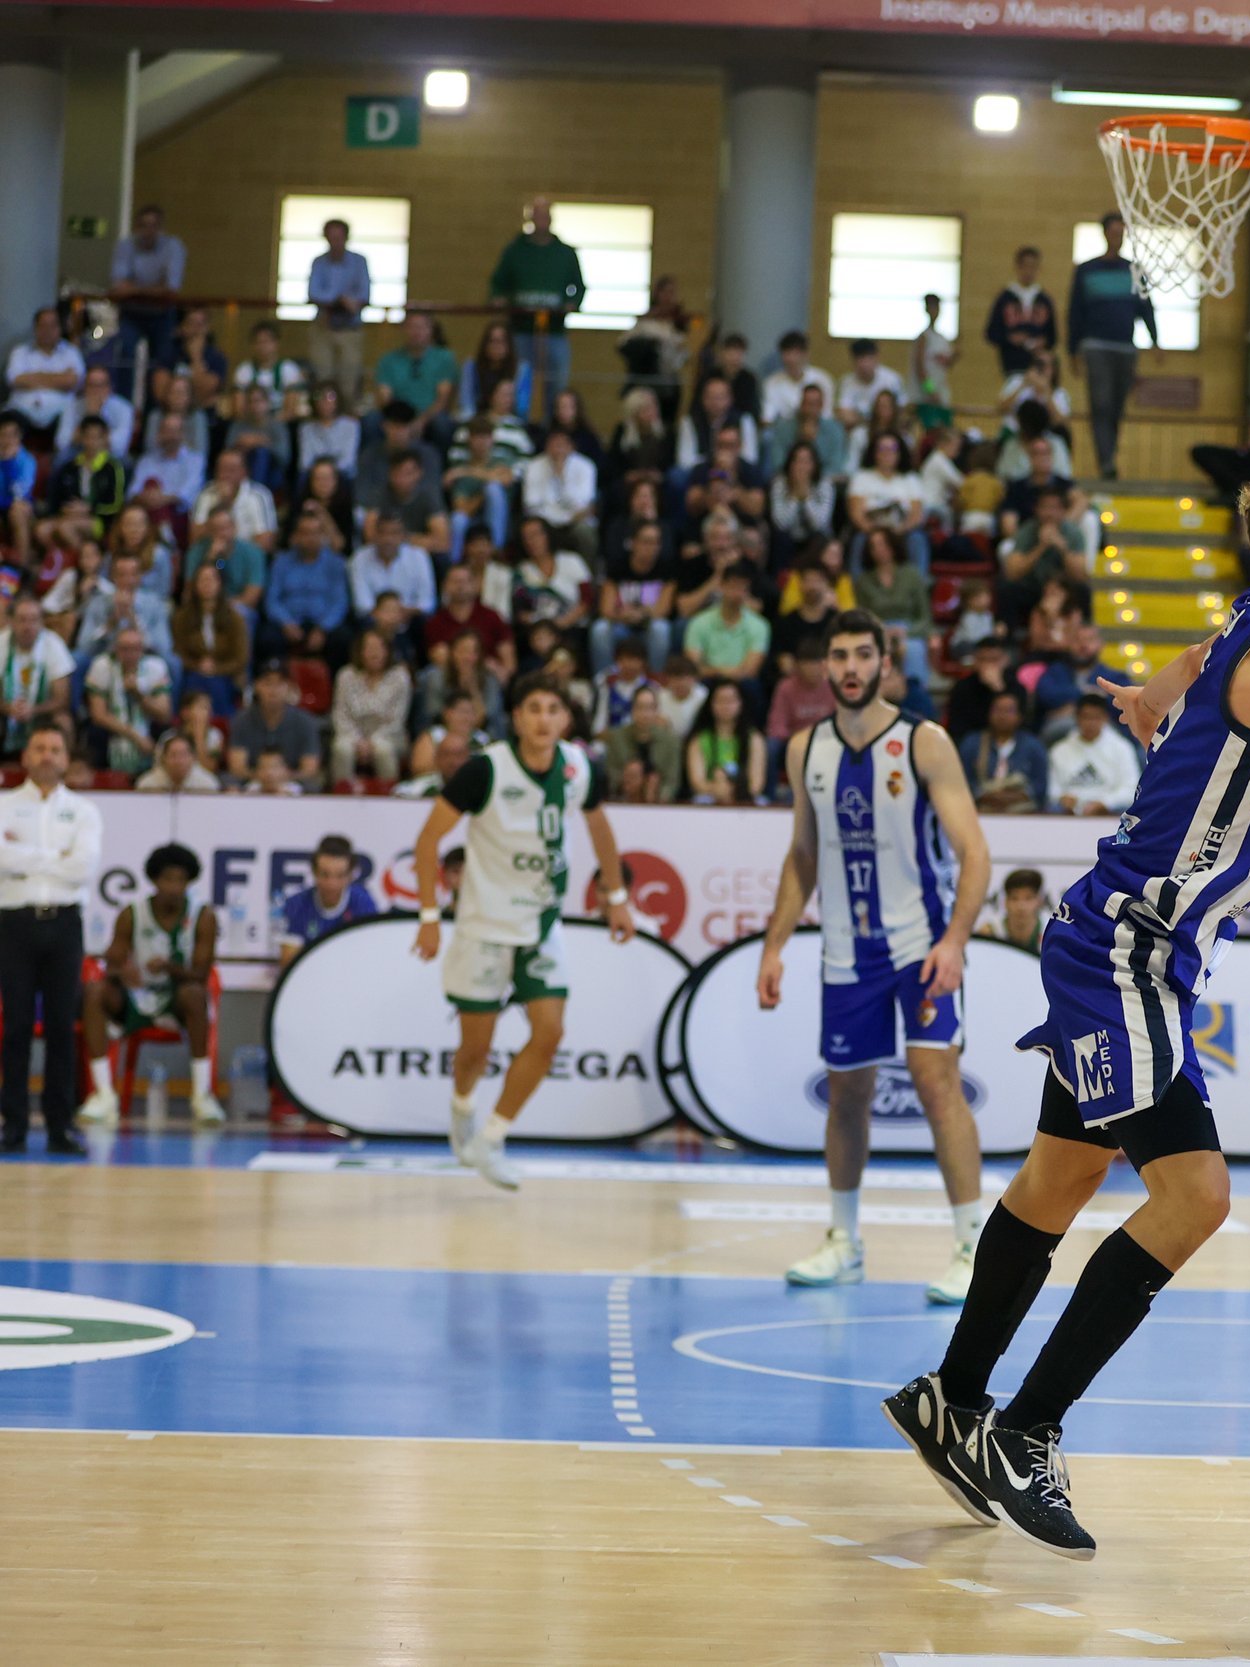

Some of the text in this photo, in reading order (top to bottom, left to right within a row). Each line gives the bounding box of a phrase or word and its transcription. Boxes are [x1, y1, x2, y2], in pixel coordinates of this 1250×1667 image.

[1151, 8, 1188, 33] de
[367, 103, 399, 141] D
[848, 861, 873, 893] 17
[1097, 1029, 1115, 1096] MEDA
